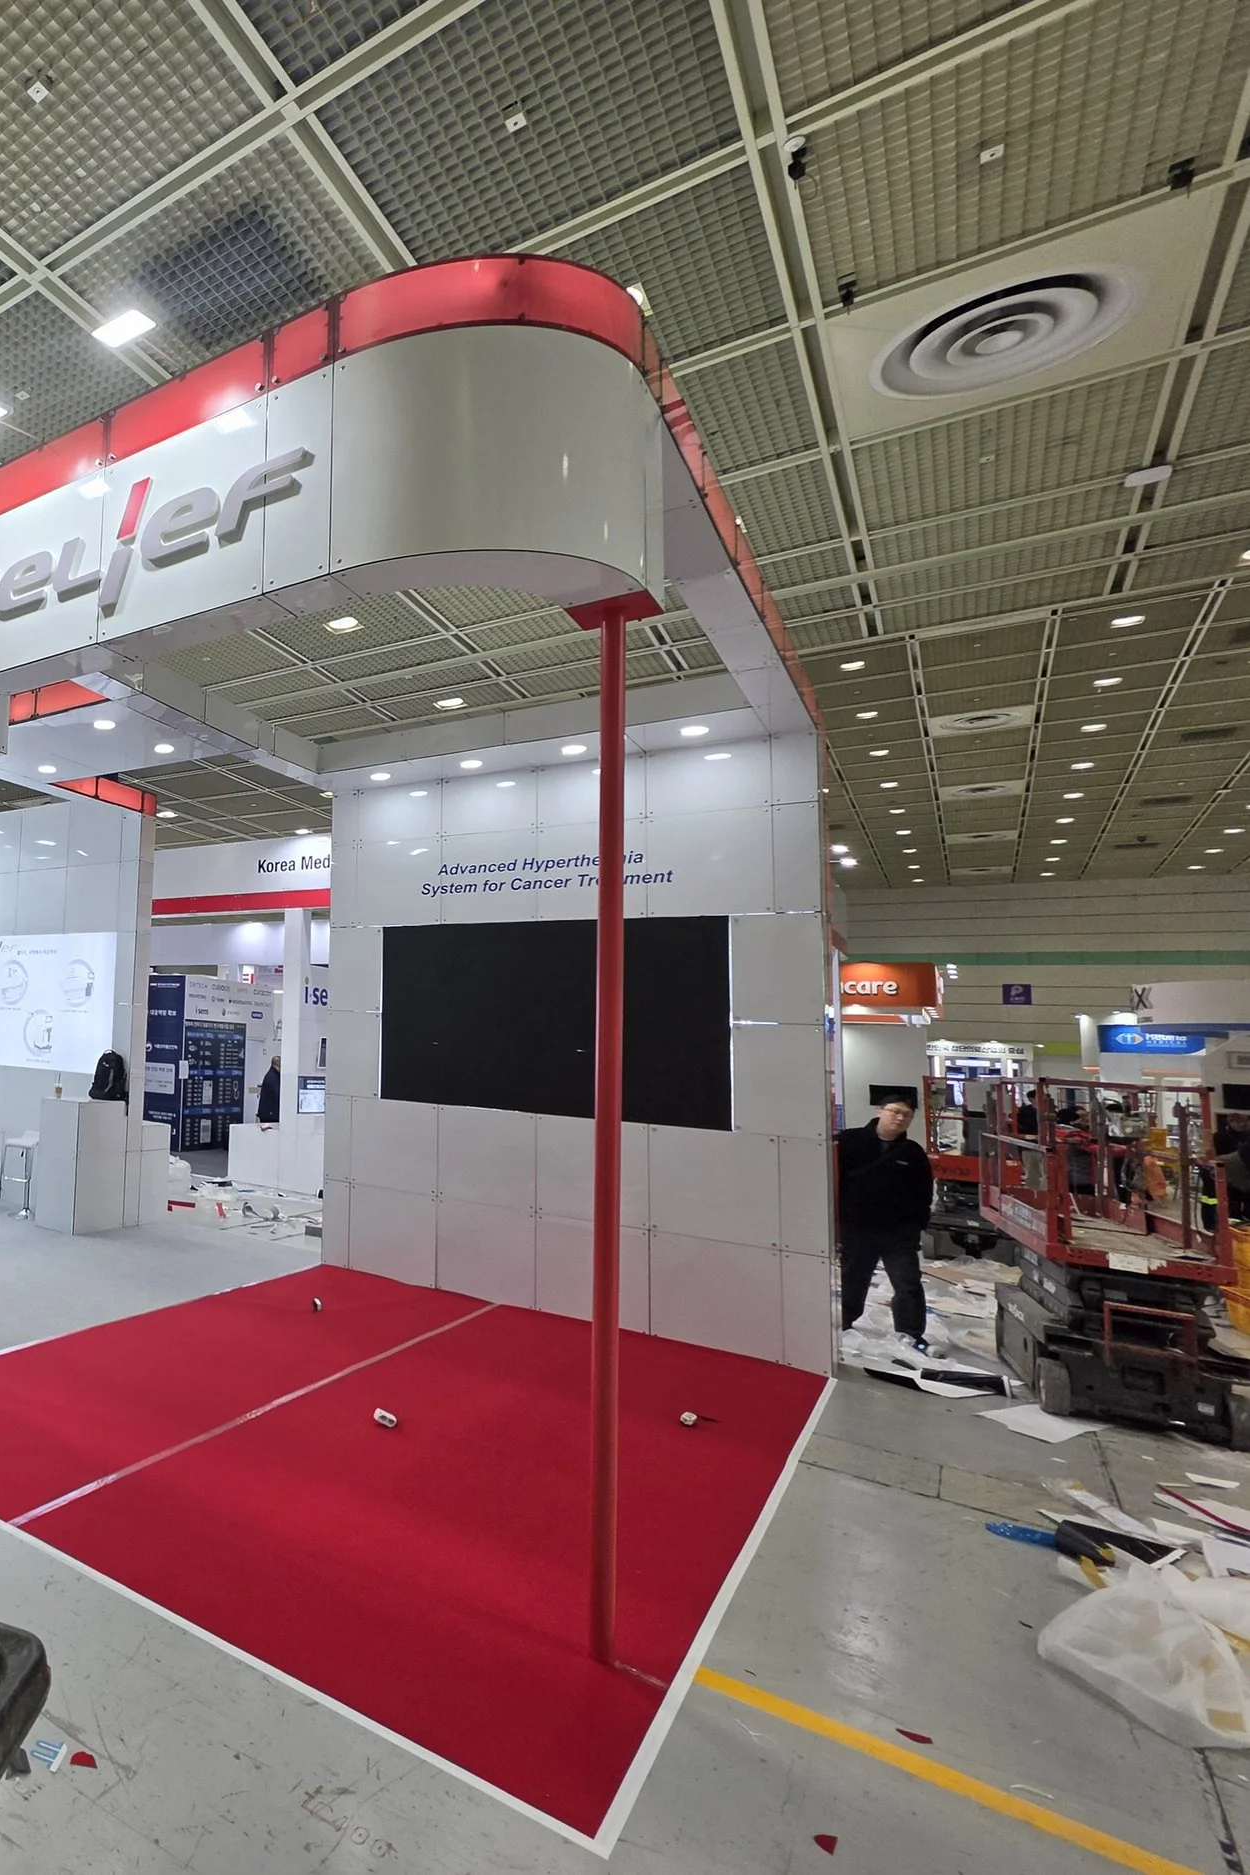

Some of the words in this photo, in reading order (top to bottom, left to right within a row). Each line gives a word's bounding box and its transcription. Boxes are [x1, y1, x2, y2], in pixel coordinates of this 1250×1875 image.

[258, 859, 296, 874] Korea
[301, 854, 331, 870] Med
[438, 859, 517, 876] Advanced
[522, 850, 644, 875] Hypertheia
[421, 881, 478, 898] System
[482, 878, 506, 893] for
[510, 875, 572, 892] Cancer
[577, 870, 674, 888] Trment
